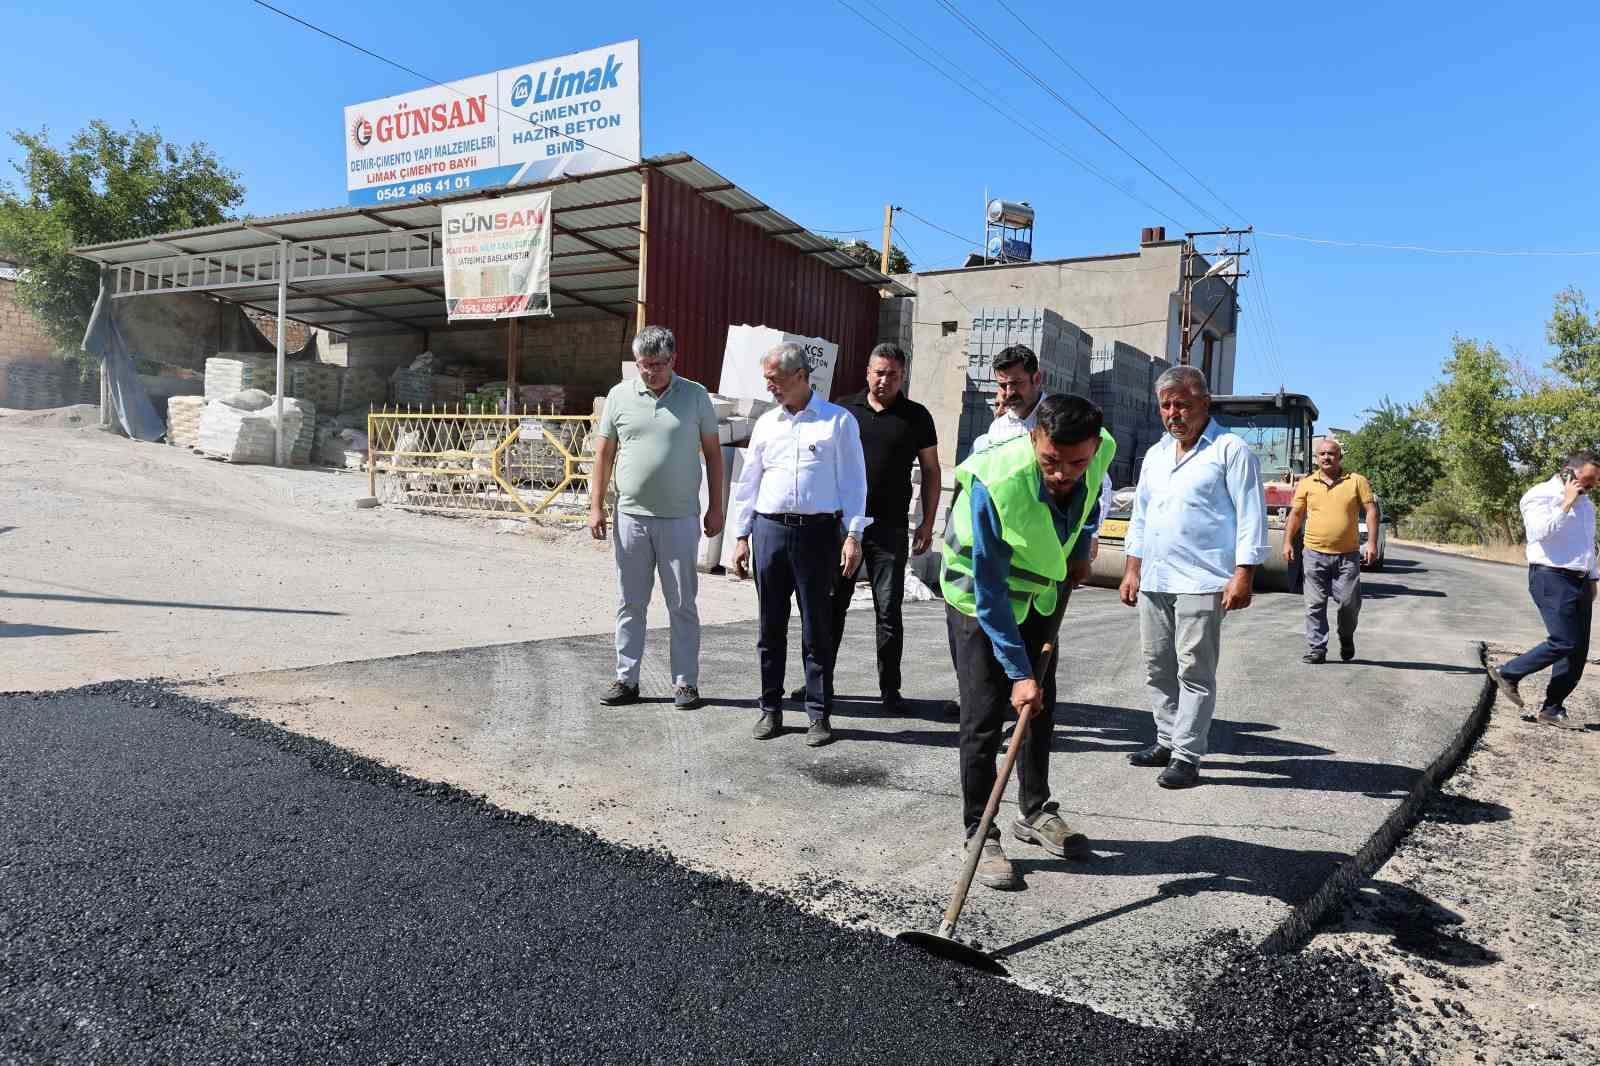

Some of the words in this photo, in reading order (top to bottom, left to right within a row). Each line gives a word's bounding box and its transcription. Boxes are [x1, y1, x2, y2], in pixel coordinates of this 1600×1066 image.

[533, 54, 623, 104] Limak
[376, 95, 487, 143] GÜNSAN
[512, 126, 560, 145] HAZIR
[565, 114, 621, 135] BETON
[414, 147, 432, 161] YAPI
[377, 186, 406, 201] 0542
[409, 182, 432, 196] 486
[435, 179, 450, 191] 41
[455, 175, 470, 189] 01
[447, 209, 543, 235] GÜNSAN
[804, 343, 824, 358] KCS
